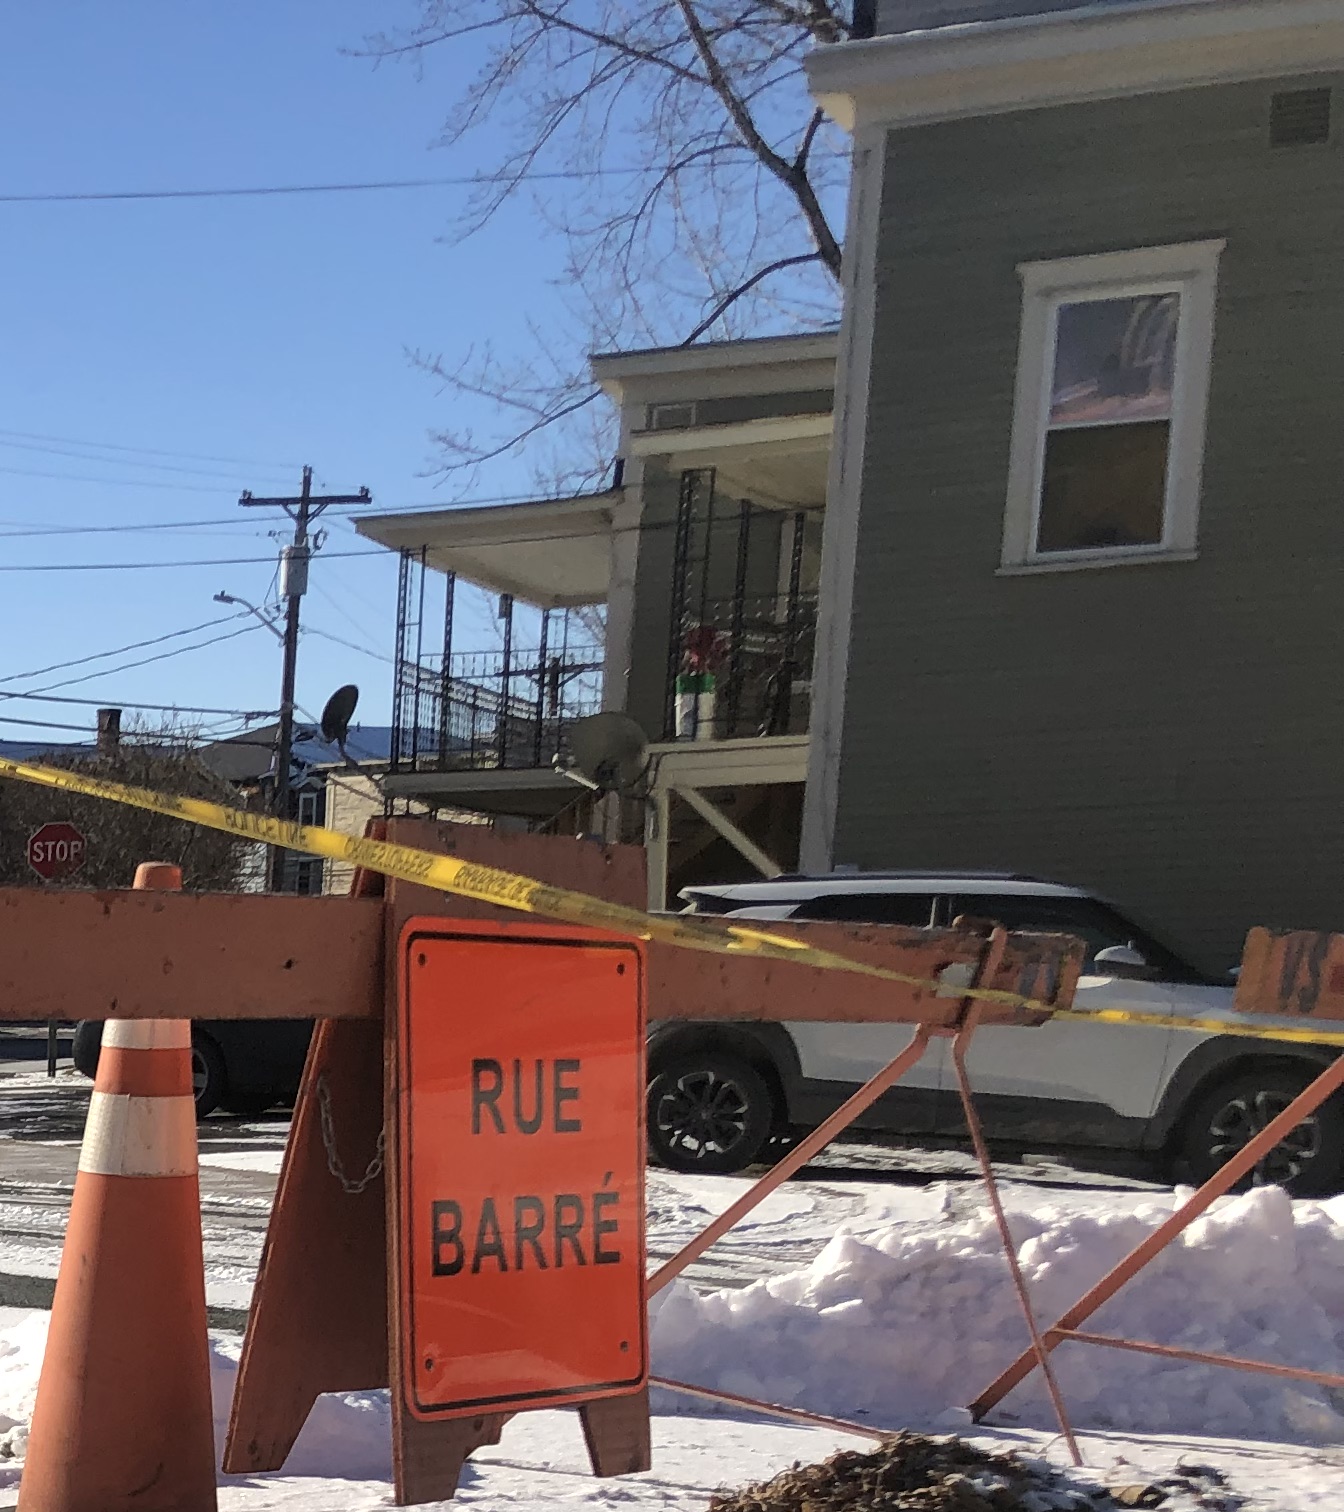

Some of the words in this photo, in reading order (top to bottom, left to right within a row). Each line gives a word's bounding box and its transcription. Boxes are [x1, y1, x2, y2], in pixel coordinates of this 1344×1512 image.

[32, 840, 83, 863] STOP
[470, 1058, 583, 1135] RUE
[431, 1171, 621, 1278] BARRÉ
